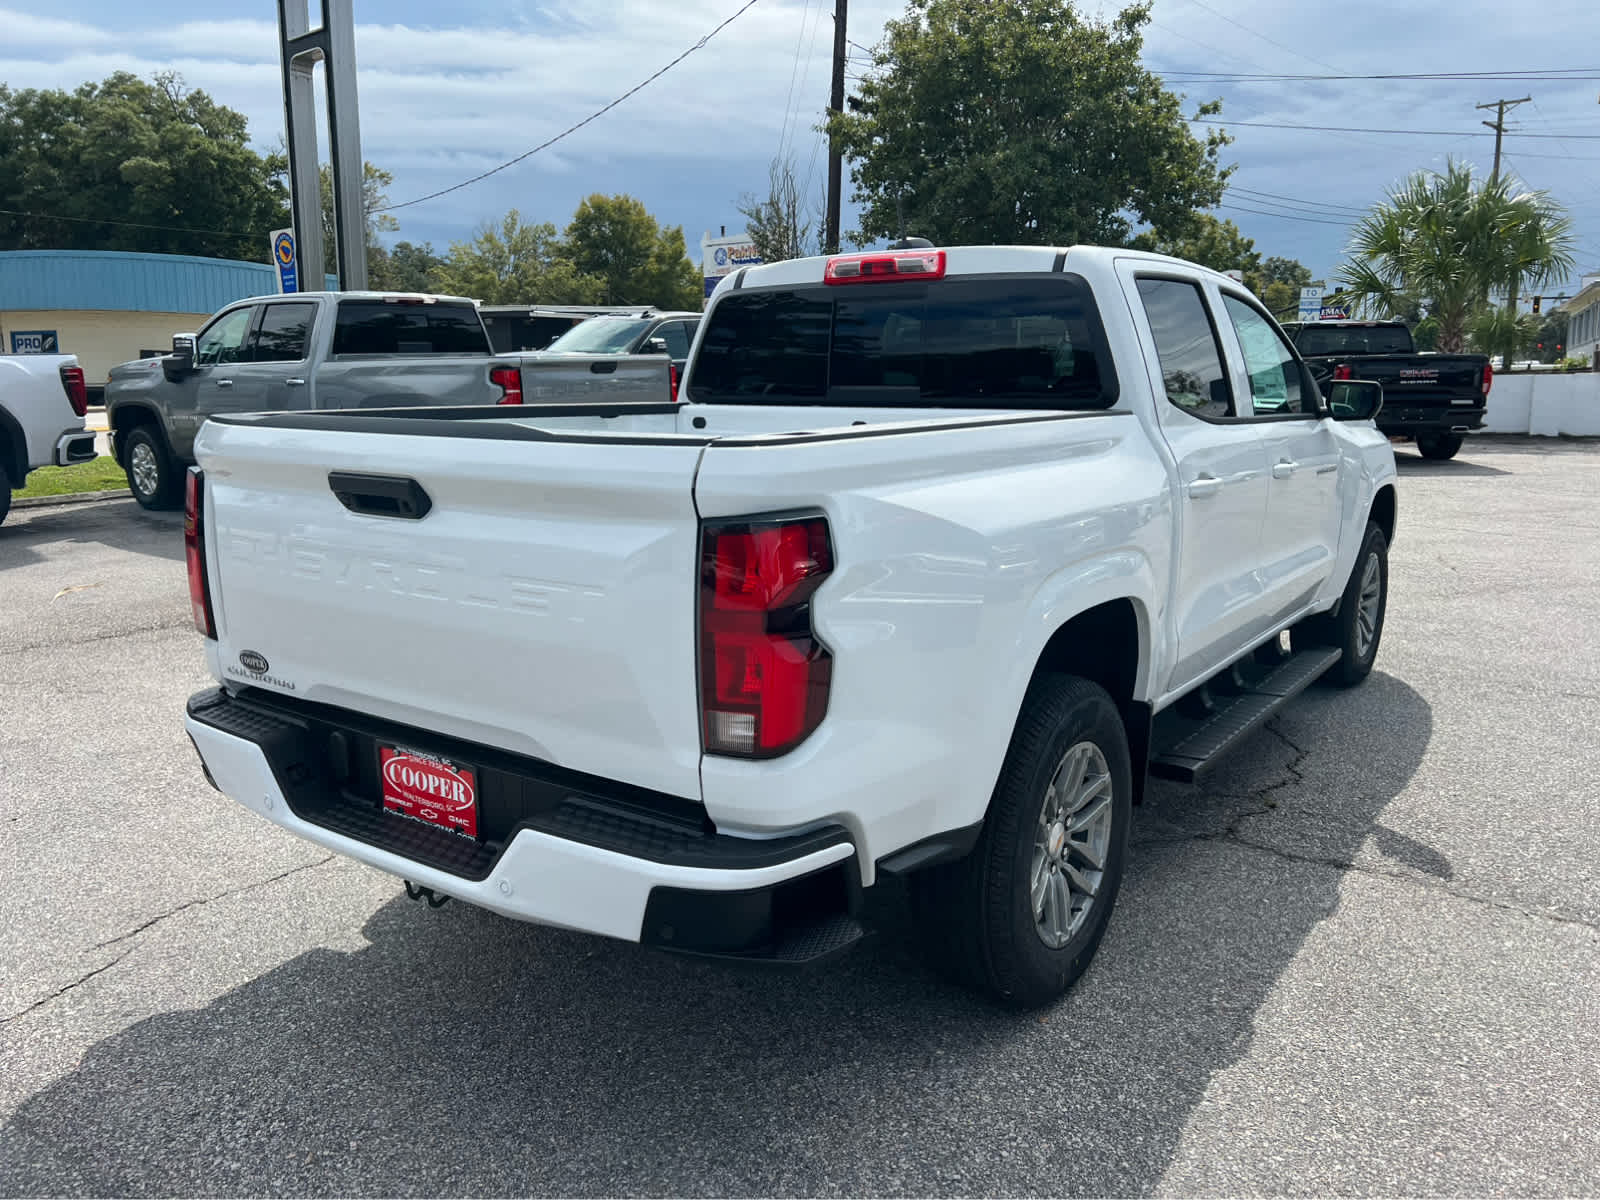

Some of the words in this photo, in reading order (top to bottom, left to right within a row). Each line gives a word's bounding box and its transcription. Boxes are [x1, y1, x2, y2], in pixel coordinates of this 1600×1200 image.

[16, 338, 41, 349] PRO
[389, 763, 466, 803] COOPER
[448, 815, 470, 827] GMC
